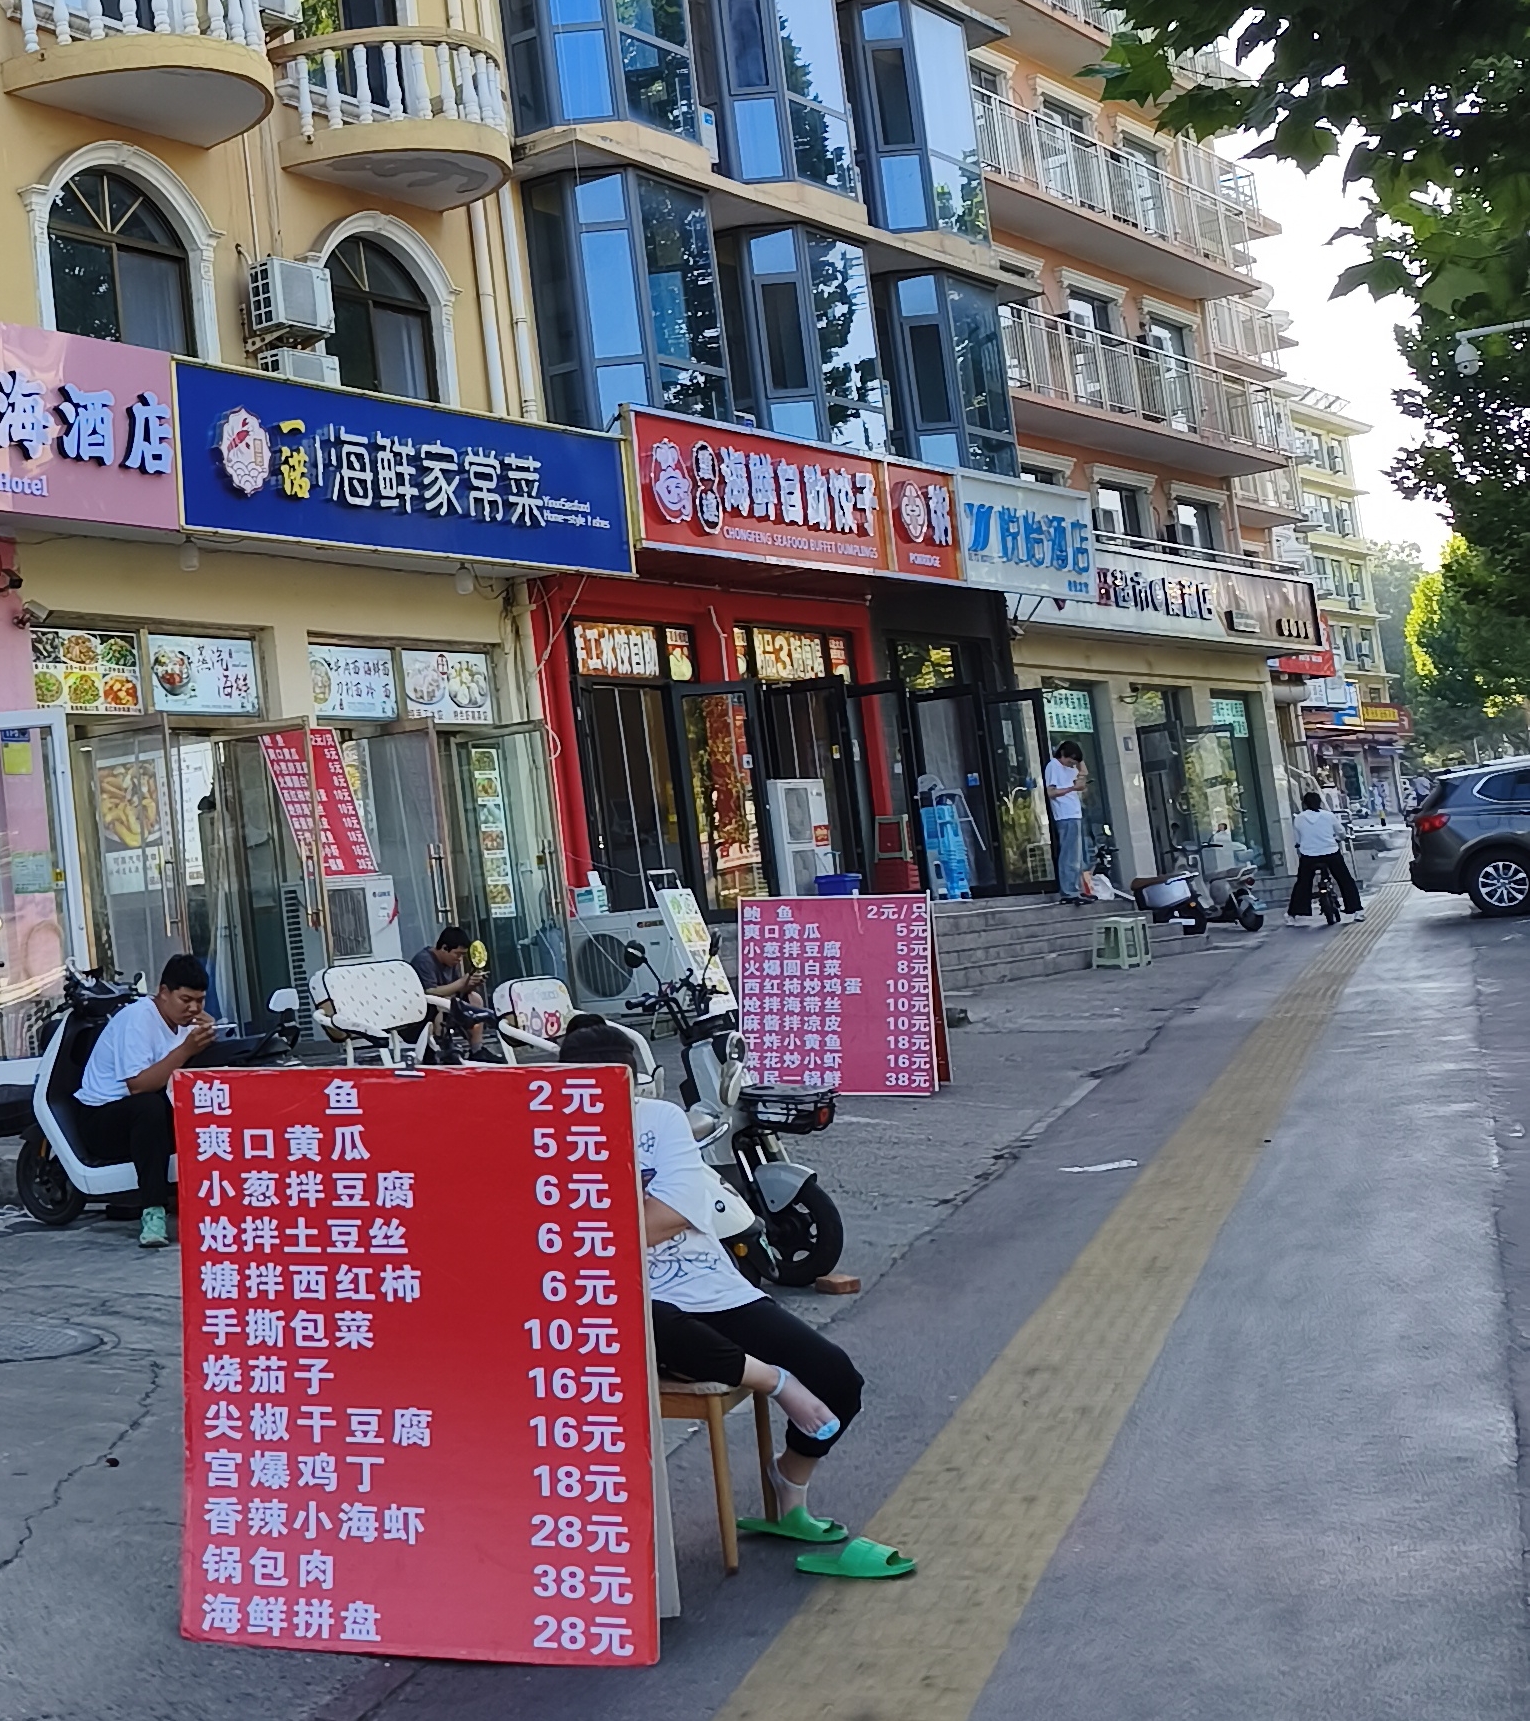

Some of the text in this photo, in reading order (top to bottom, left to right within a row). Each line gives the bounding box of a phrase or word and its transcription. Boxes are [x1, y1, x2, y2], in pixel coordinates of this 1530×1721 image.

[329, 423, 546, 528] 海鲜家常菜
[772, 534, 809, 551] SEAFOOD
[810, 538, 837, 555] BUFFET
[744, 922, 928, 939] 爽口黄瓜 5元
[867, 903, 928, 920] 2元/只
[744, 941, 928, 957] 小葱拌豆腐 5元
[897, 959, 928, 975] 8元
[744, 978, 929, 994] 西红柿炒鸡蛋 10元
[744, 997, 929, 1013] 炝拌海带丝 10元
[744, 1016, 929, 1032] 麻酱拌凉皮 10元
[745, 1034, 930, 1050] 干炸小黄鱼 18元
[746, 1053, 930, 1069] 菜花炒小虾 16元
[885, 1072, 930, 1087] 38元
[191, 1078, 605, 1116] 鲍 鱼 2元
[195, 1124, 610, 1162] 爽口黄瓜 5元
[197, 1170, 612, 1210] 小葱拌豆腐 6元
[198, 1215, 616, 1258] 炝拌土豆丝 6元
[200, 1260, 618, 1306] 糖拌西红柿 6元
[201, 1307, 621, 1355] 手撕包菜 10元
[202, 1354, 624, 1404] 烧茄子 16元
[204, 1400, 626, 1453] 尖椒干豆腐 16元
[204, 1448, 628, 1503] 宫爆鸡丁 18元
[203, 1496, 631, 1554] 香辣小海虾 28元
[202, 1543, 634, 1605] 锅包肉 38元
[201, 1592, 635, 1657] 海鲜拼盘 28元
